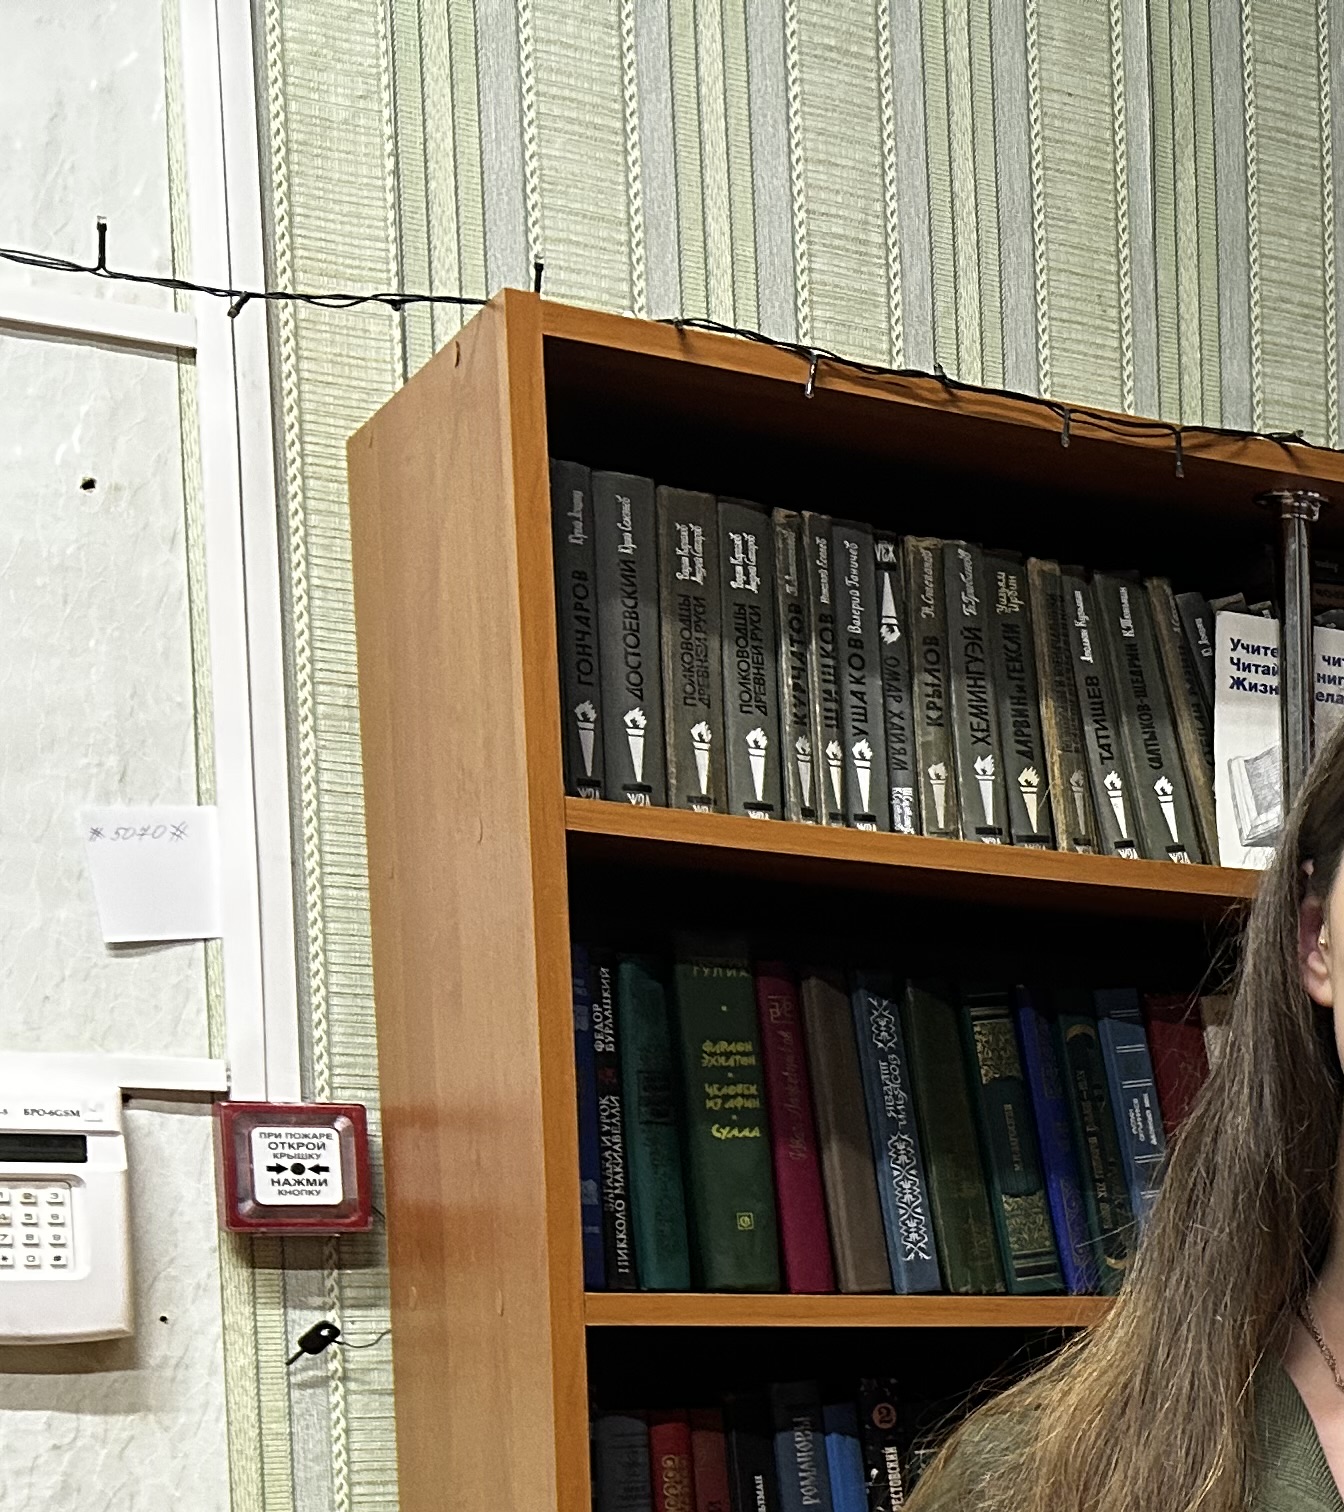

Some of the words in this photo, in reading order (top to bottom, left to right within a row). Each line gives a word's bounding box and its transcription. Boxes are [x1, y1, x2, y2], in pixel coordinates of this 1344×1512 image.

[572, 570, 594, 687] ГОНЧАРОВ
[619, 559, 643, 701] ДОСТОЕВСКИЙ
[750, 605, 763, 642] РУСИ
[1000, 623, 1025, 682] ГЕКСЛИ
[1229, 637, 1279, 659] Учите
[732, 602, 753, 715] ПОЛКОВОДЦЫ
[751, 645, 768, 716] ДРЕВНЕЙ
[788, 603, 807, 727] КУРЧАТОВ
[848, 638, 868, 737] УШАКОВ
[923, 635, 944, 727] КРЫЛОВ
[961, 626, 992, 745] ХЕМИНГУЭЙ
[1229, 676, 1279, 695] Жизн
[1230, 656, 1279, 676] Читай
[1011, 696, 1034, 761] ДАРВИН
[1085, 676, 1115, 765] ТАТИЩЕВ
[593, 1003, 603, 1052] ФЕДОР
[259, 1131, 282, 1139] ПРИ
[285, 1132, 333, 1140] ПОЖАРЕ
[268, 1141, 326, 1151] ОТКРОЙ
[273, 1152, 321, 1160] КРЫШКУ
[271, 1178, 328, 1187] НАЖМИ
[278, 1188, 321, 1196] КНОПКУ
[616, 1200, 630, 1273] НИККОЛО
